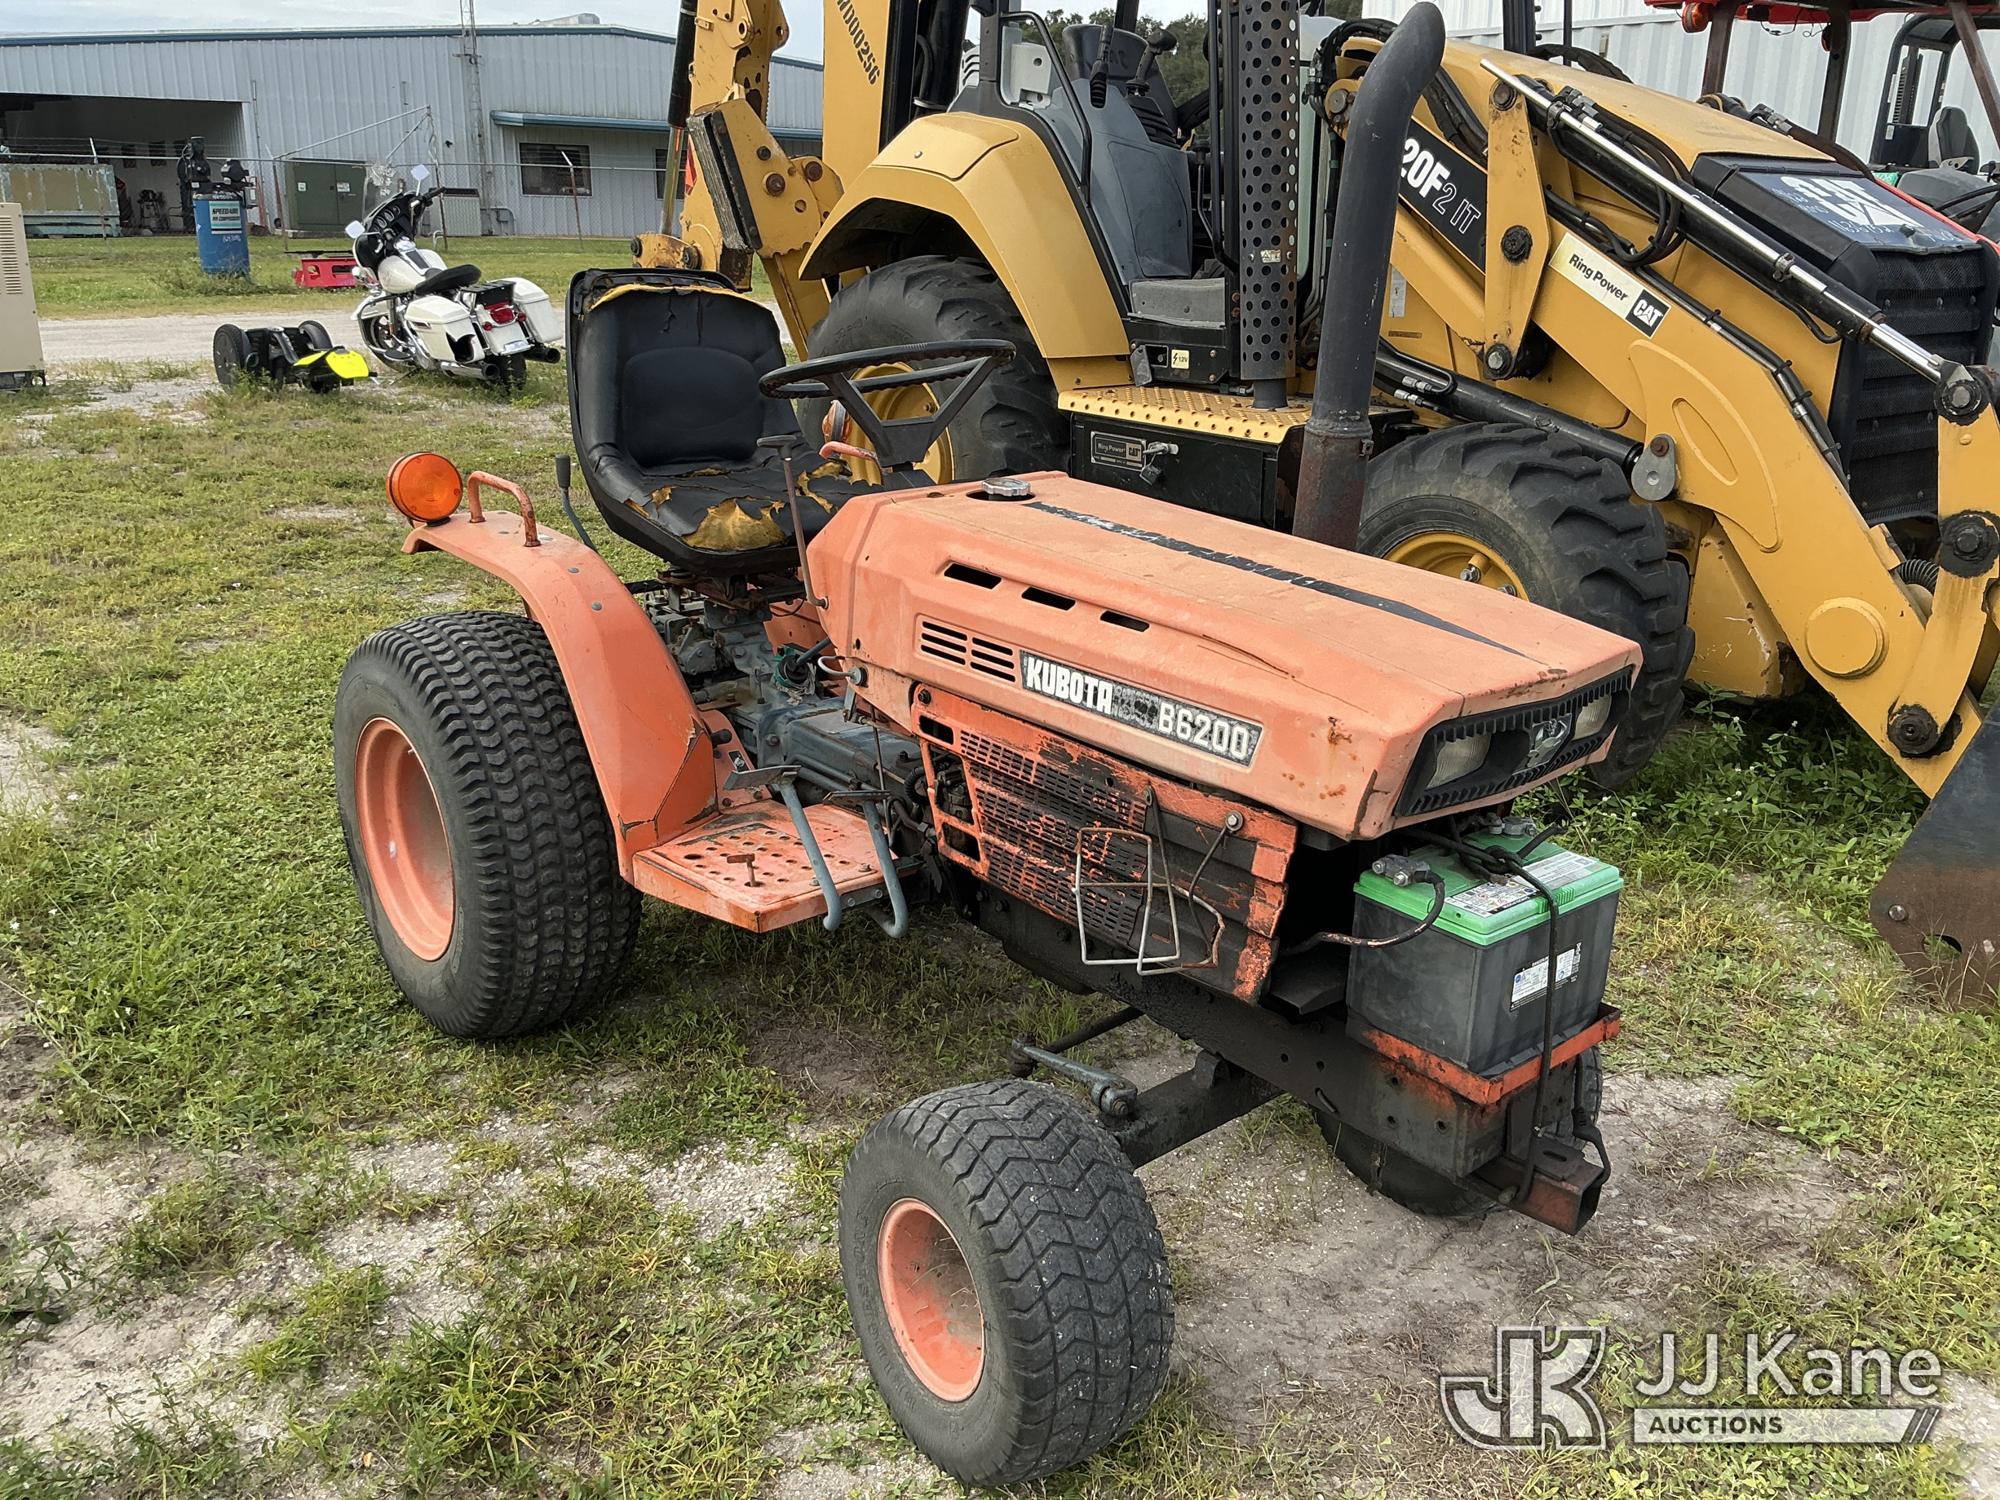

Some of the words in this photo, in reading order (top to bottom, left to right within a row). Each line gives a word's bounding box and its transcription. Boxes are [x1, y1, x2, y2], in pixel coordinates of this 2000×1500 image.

[1449, 198, 1482, 235] IT
[1568, 253, 1594, 280] Ring
[1592, 270, 1629, 301] Power
[1633, 299, 1664, 327] CAT
[1026, 655, 1115, 715] KUBOTA
[1158, 701, 1251, 760] B6200
